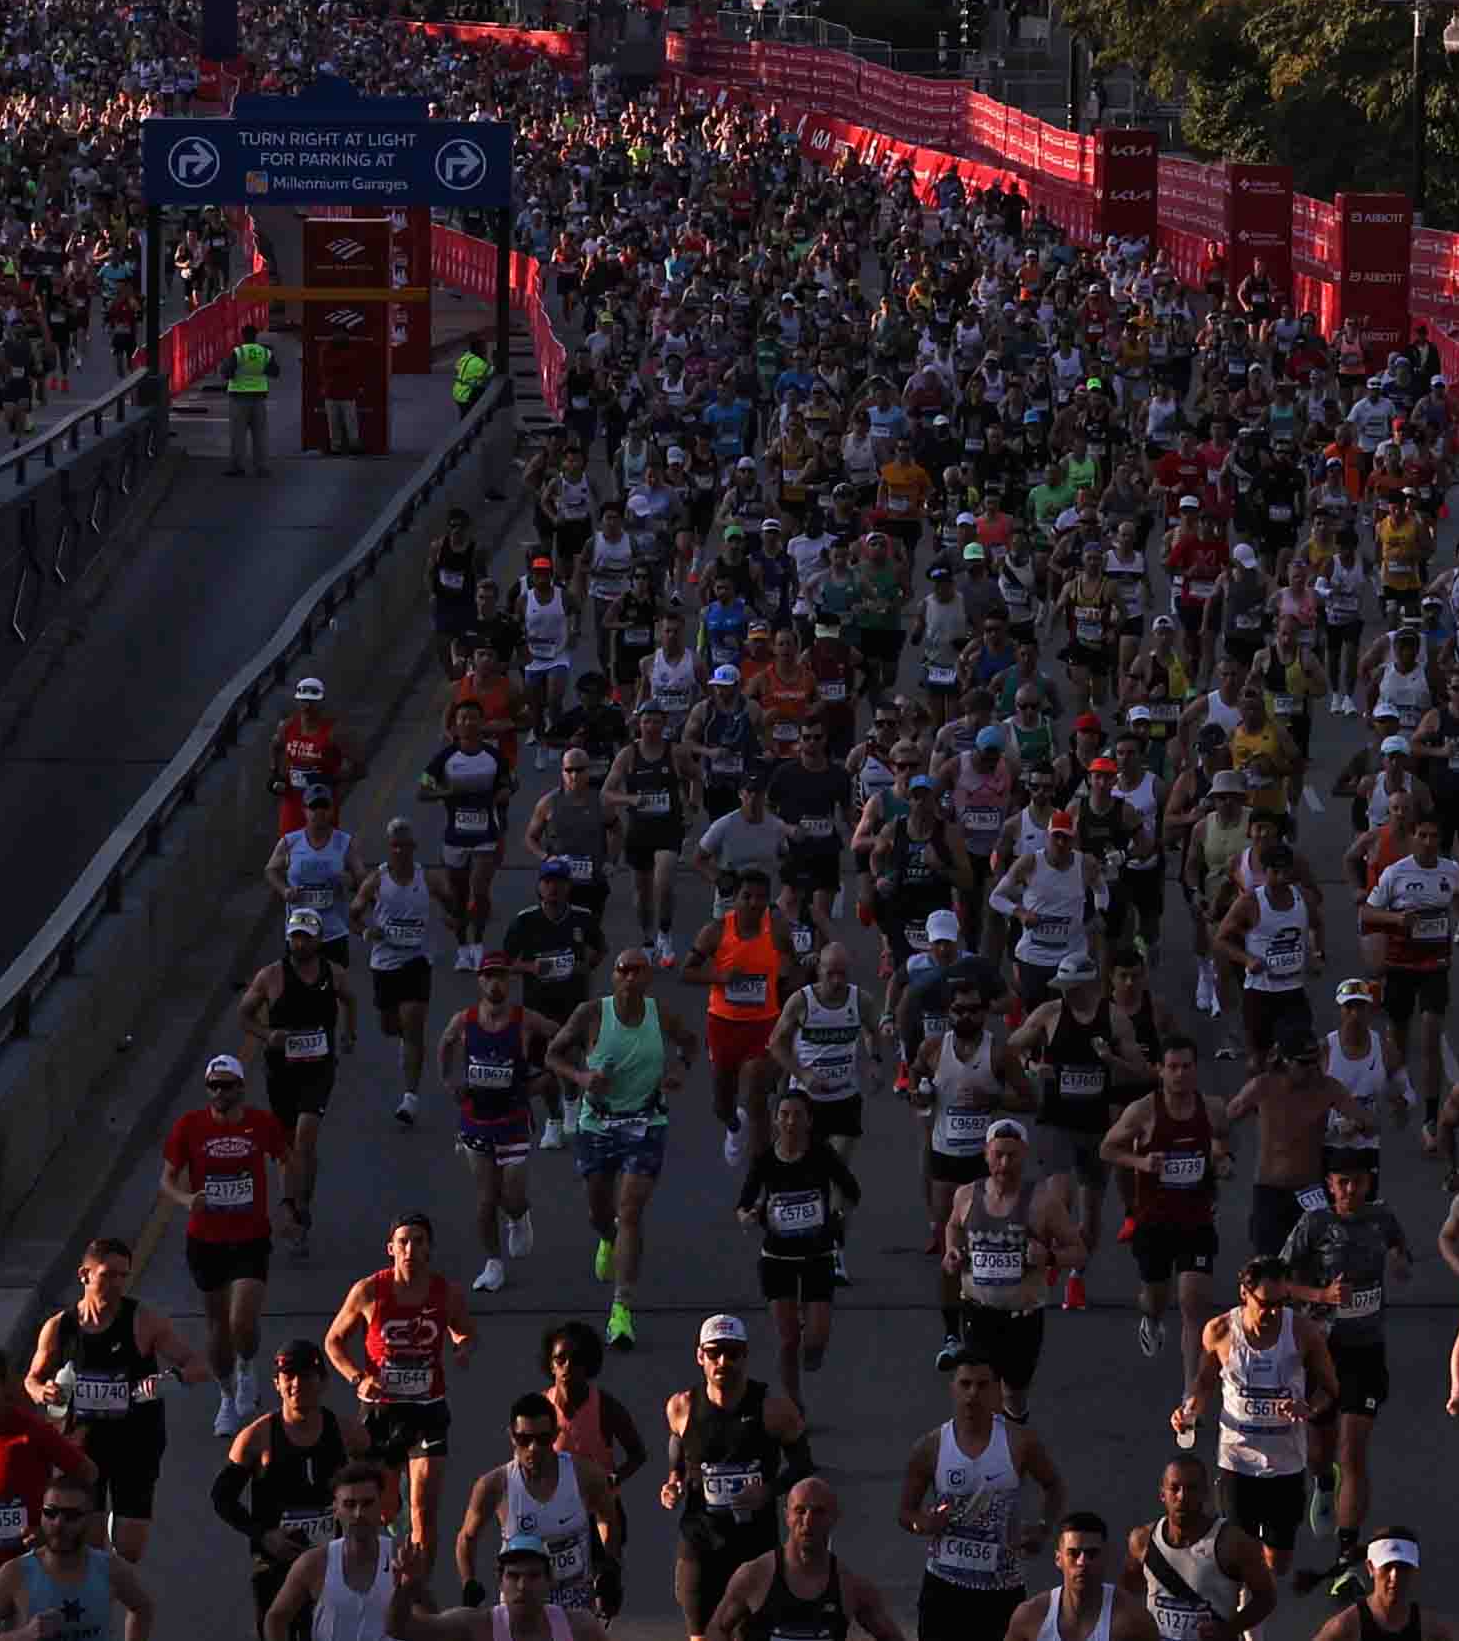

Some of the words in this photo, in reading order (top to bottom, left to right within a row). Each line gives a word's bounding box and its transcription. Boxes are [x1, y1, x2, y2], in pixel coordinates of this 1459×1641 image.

[238, 133, 286, 147] TURN
[289, 133, 341, 147] RIGHT
[343, 133, 363, 147] AT
[367, 133, 418, 147] LIGHT
[260, 152, 295, 167] FOR
[298, 152, 372, 167] PARKING
[374, 152, 397, 167] AT
[272, 175, 349, 190] Millennium
[351, 176, 408, 192] Garages
[205, 1181, 253, 1199] C21755
[973, 1252, 1022, 1269] C20635
[75, 1383, 128, 1400] C11740
[946, 1540, 991, 1560] C4636
